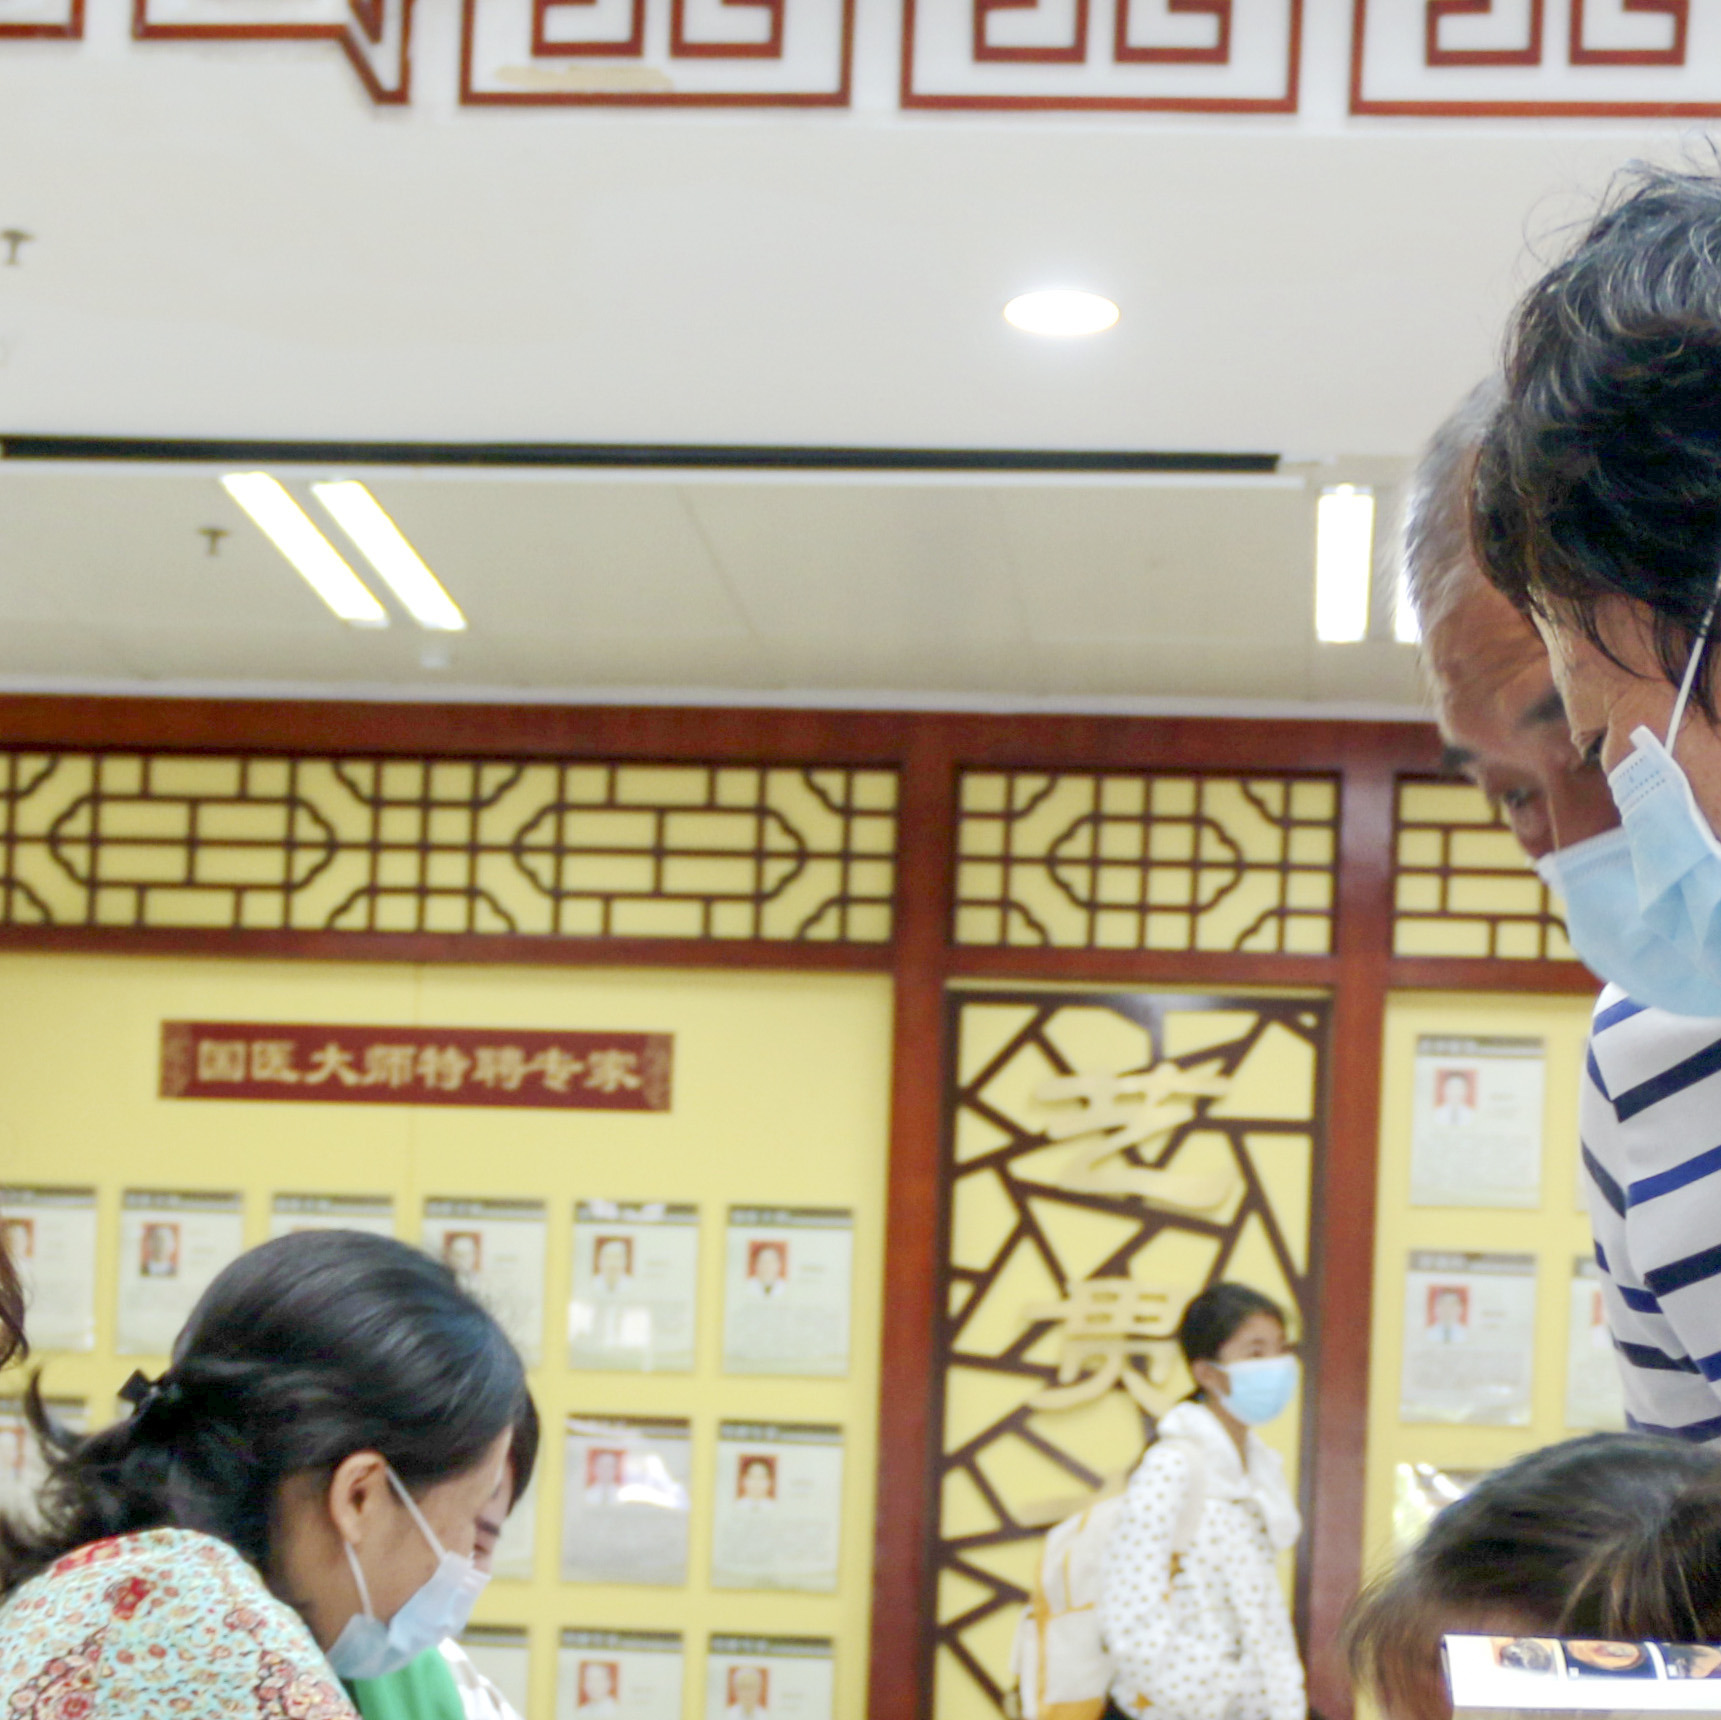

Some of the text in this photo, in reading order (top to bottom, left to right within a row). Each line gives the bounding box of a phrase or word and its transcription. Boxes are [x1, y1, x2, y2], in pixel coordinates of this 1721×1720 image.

[195, 1038, 644, 1094] 国医大师特聘专家
[1022, 1062, 1237, 1526] 艺贯
